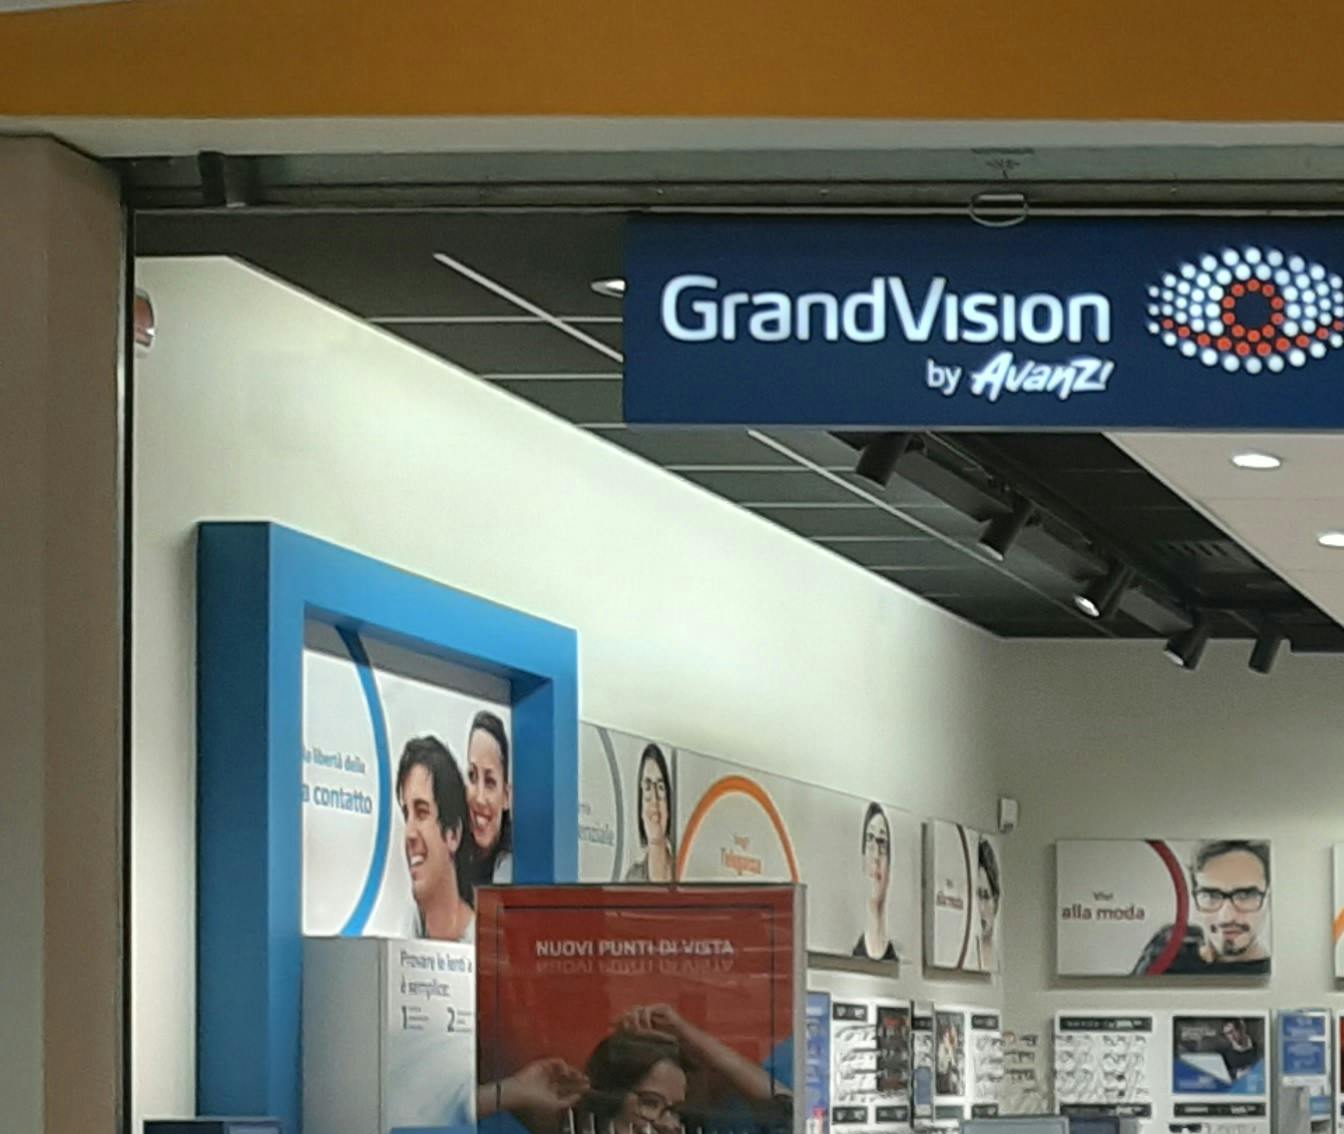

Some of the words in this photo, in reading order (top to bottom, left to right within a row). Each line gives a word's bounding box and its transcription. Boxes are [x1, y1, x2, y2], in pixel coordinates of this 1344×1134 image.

[661, 274, 1111, 343] GrandVision
[927, 359, 961, 395] by
[313, 785, 373, 815] contatto
[1062, 903, 1092, 920] alla
[1097, 902, 1145, 920] moda
[536, 940, 593, 957] NUOVI
[600, 940, 652, 957] PUNTI
